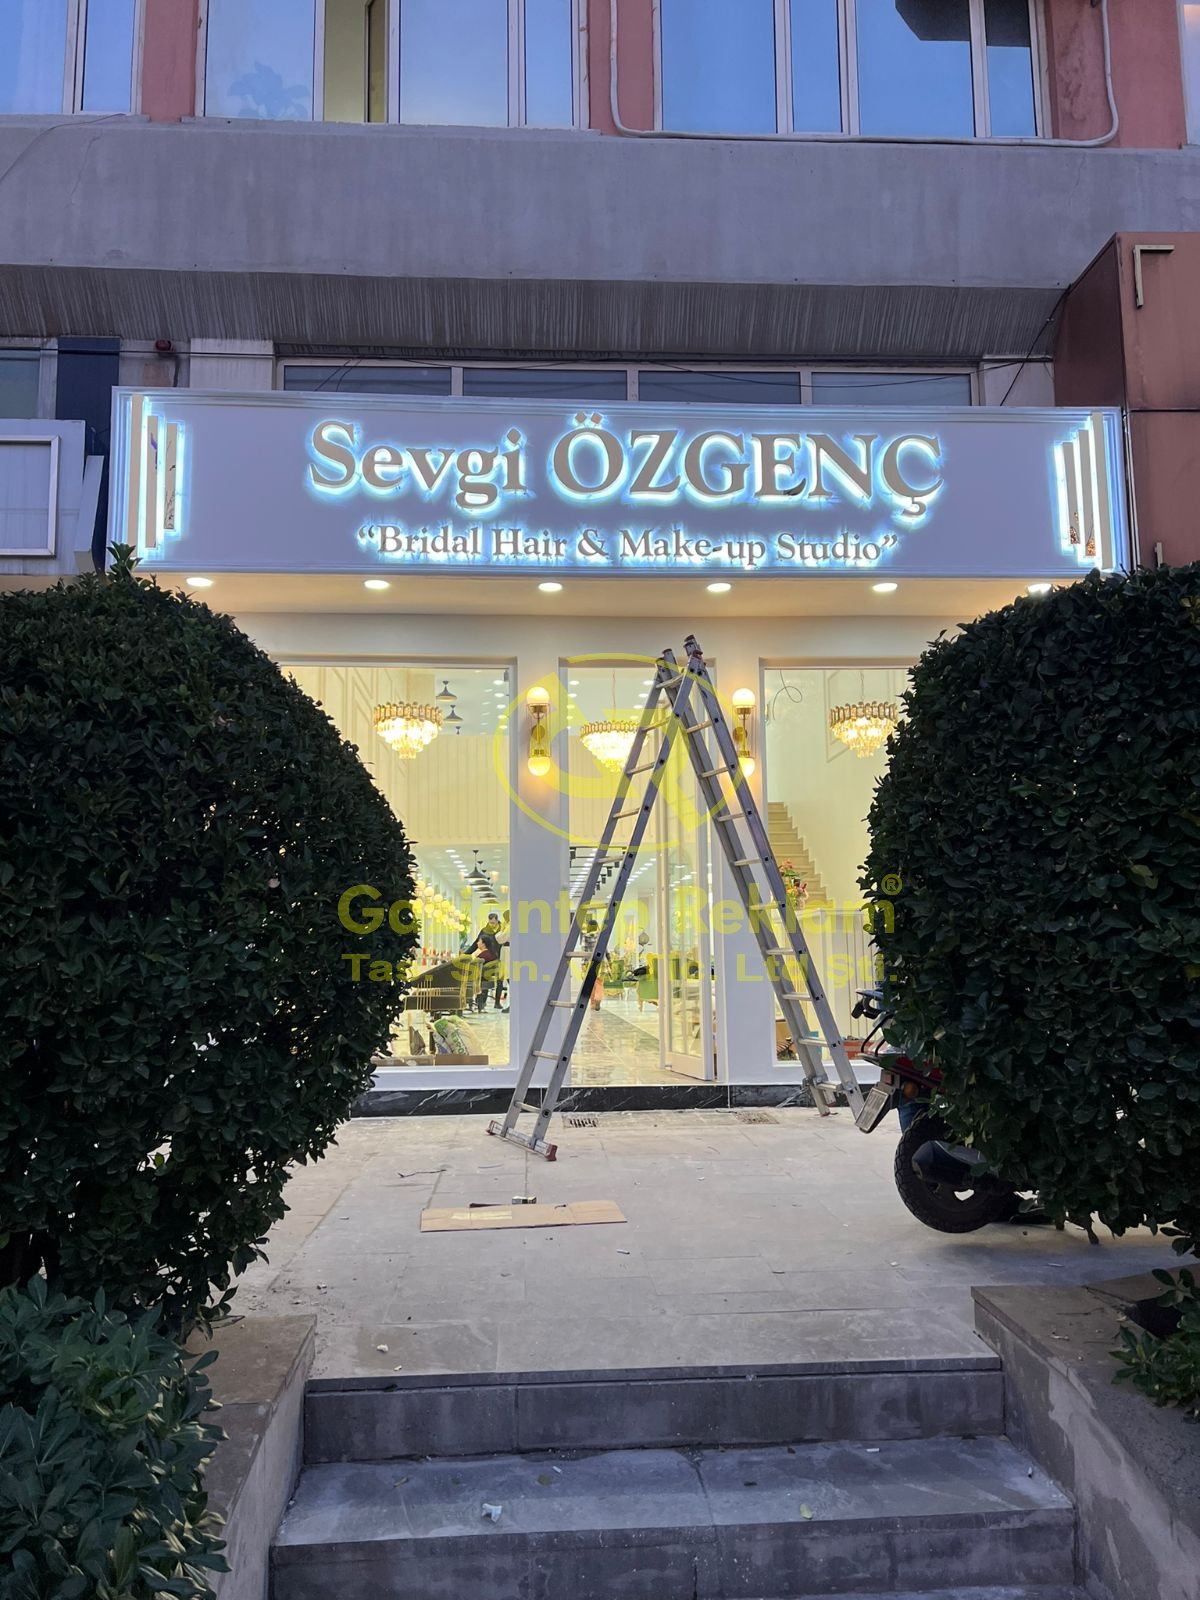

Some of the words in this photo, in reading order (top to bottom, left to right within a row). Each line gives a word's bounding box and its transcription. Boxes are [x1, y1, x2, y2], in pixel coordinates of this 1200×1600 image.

[308, 420, 527, 508] Sevgi
[552, 412, 943, 520] ÖZGENÇ
[491, 527, 567, 558] Hair
[576, 529, 609, 560] &
[619, 529, 767, 567] Make-up
